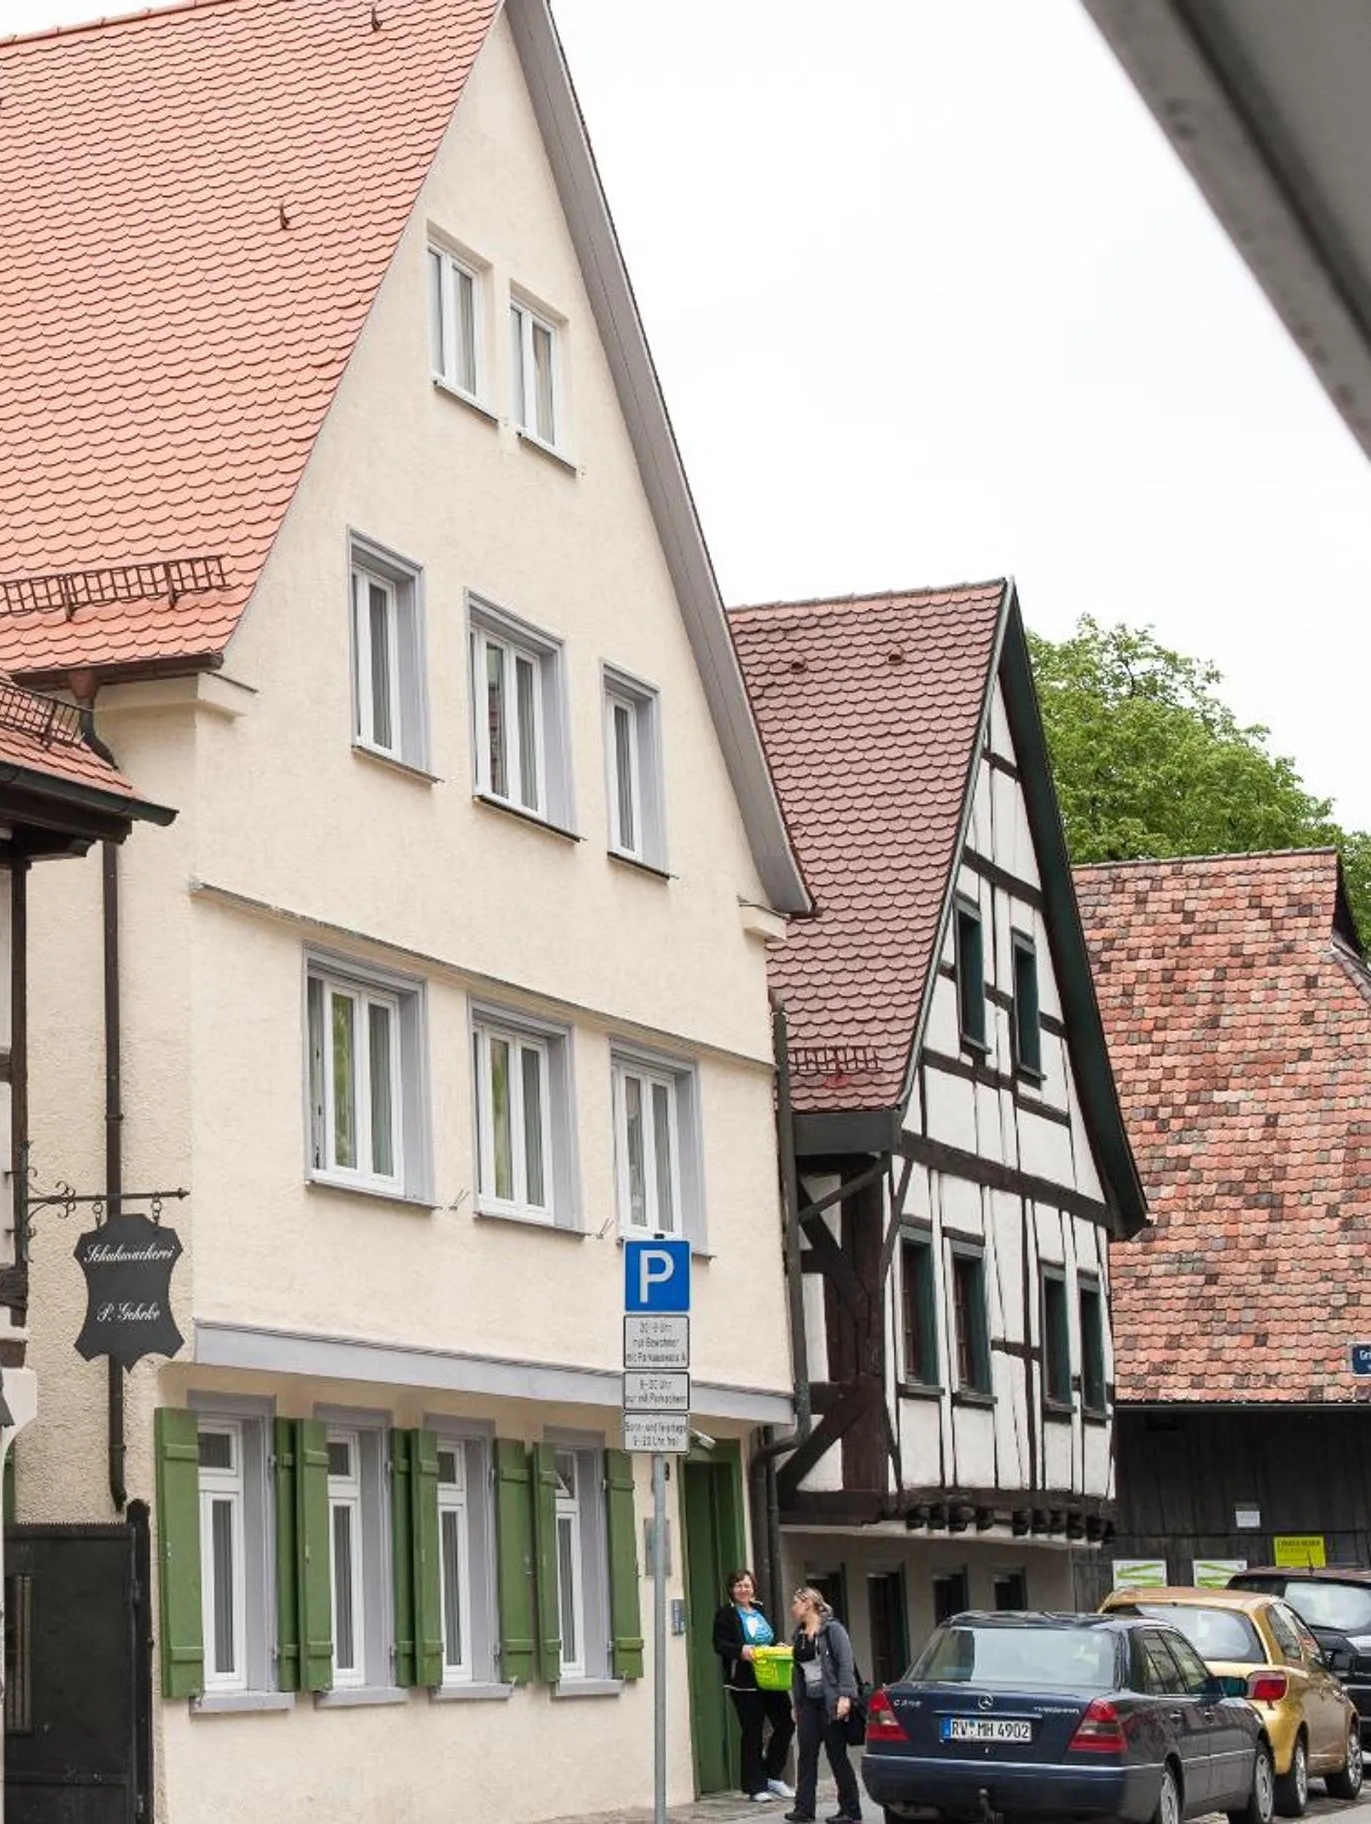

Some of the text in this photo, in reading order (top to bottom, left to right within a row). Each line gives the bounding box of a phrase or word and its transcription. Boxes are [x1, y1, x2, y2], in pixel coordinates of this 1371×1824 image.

[84, 1243, 175, 1263] Schuhmacherei
[640, 1250, 674, 1303] P
[118, 1301, 160, 1322] Gehrke
[952, 1721, 1029, 1739] RV MH 4902
